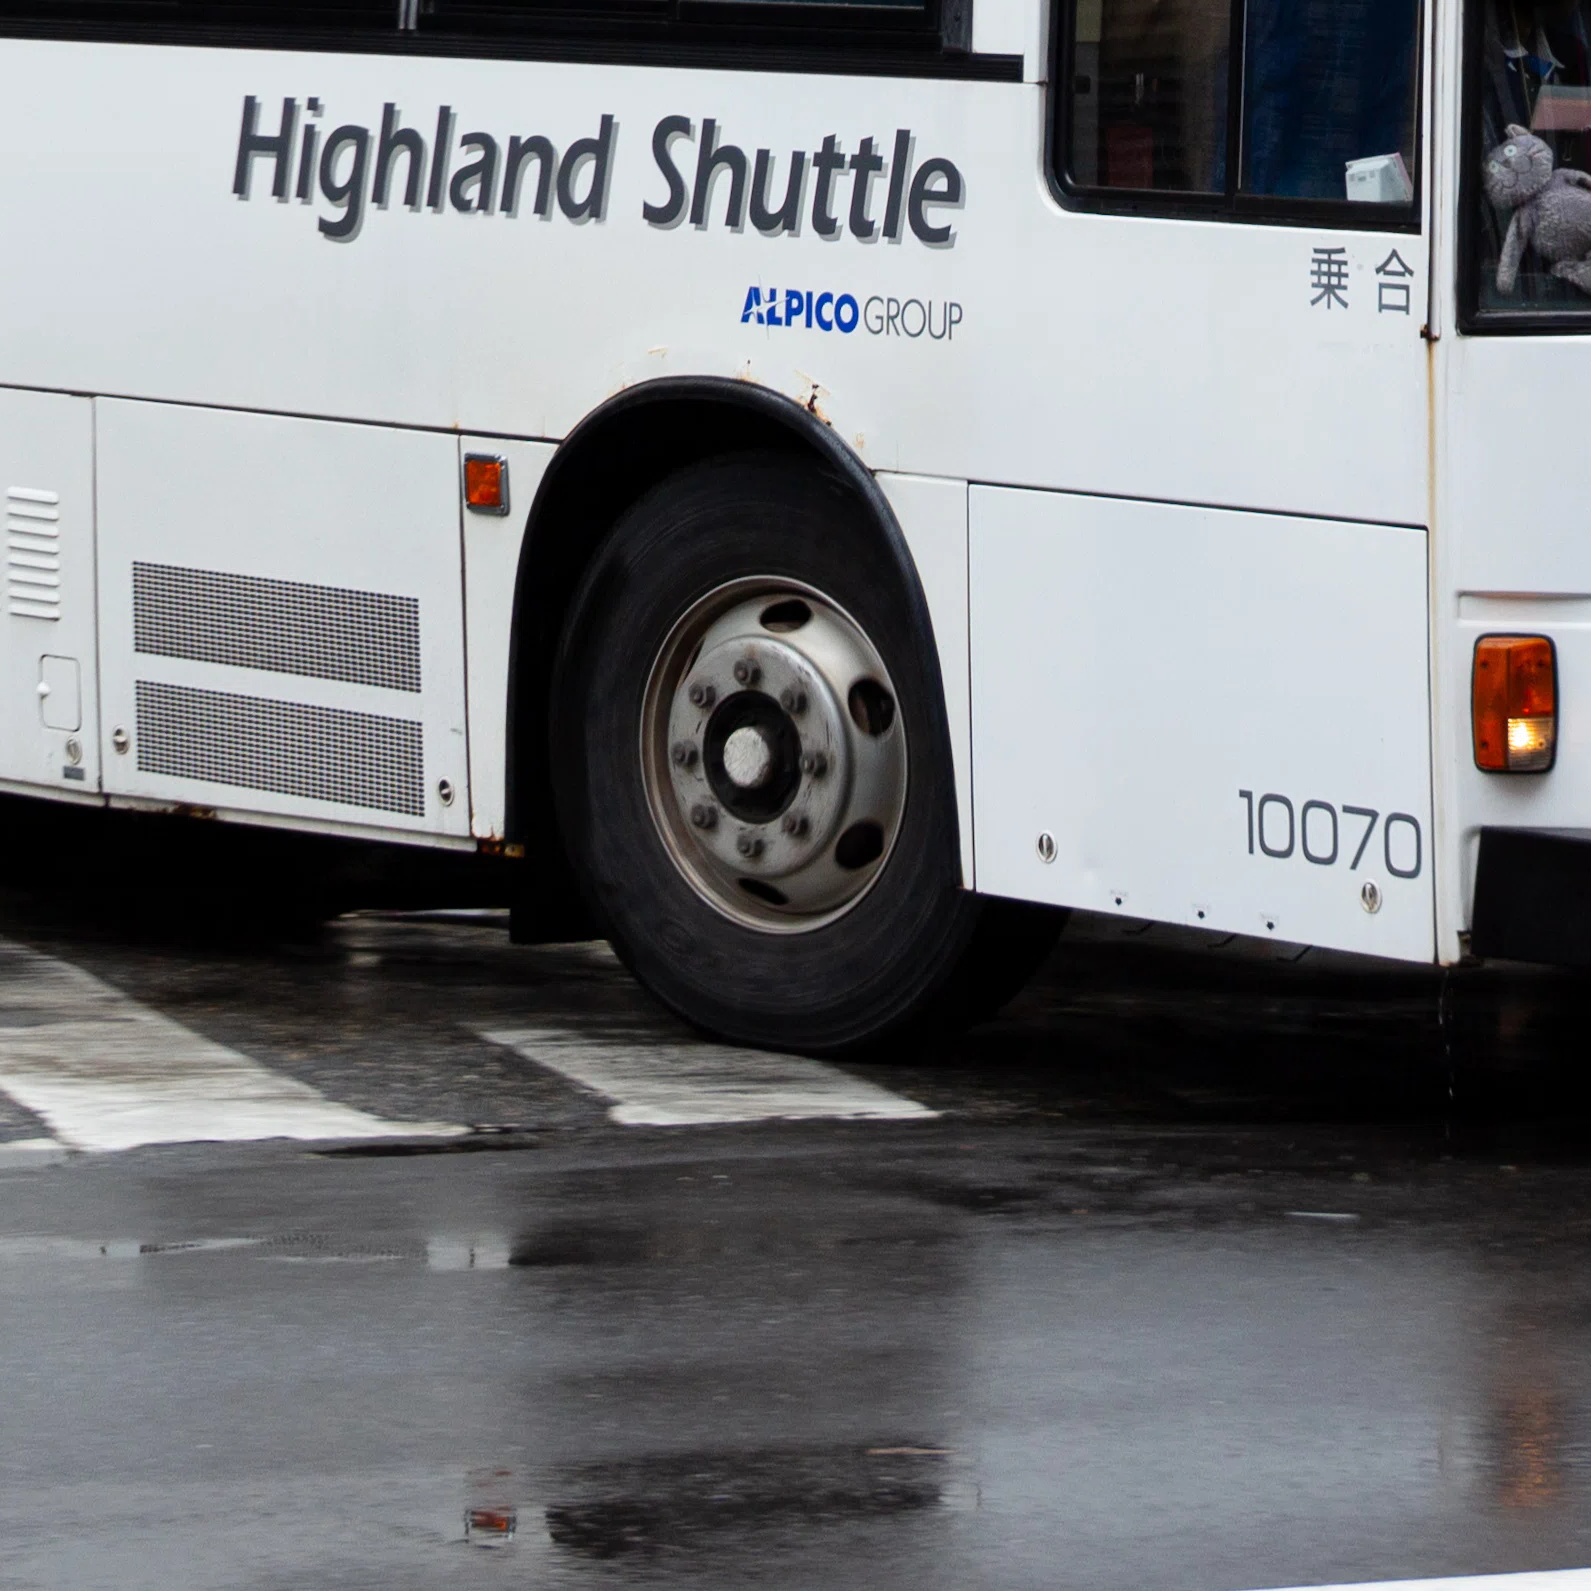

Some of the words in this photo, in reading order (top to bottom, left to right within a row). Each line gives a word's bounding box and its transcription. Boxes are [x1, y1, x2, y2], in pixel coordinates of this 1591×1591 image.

[232, 94, 619, 241] Highland
[642, 113, 964, 249] Shuttle
[740, 285, 859, 334] ALPICO
[863, 295, 964, 341] GROUP
[1309, 247, 1415, 316] 乗合
[1238, 789, 1423, 880] 10070
